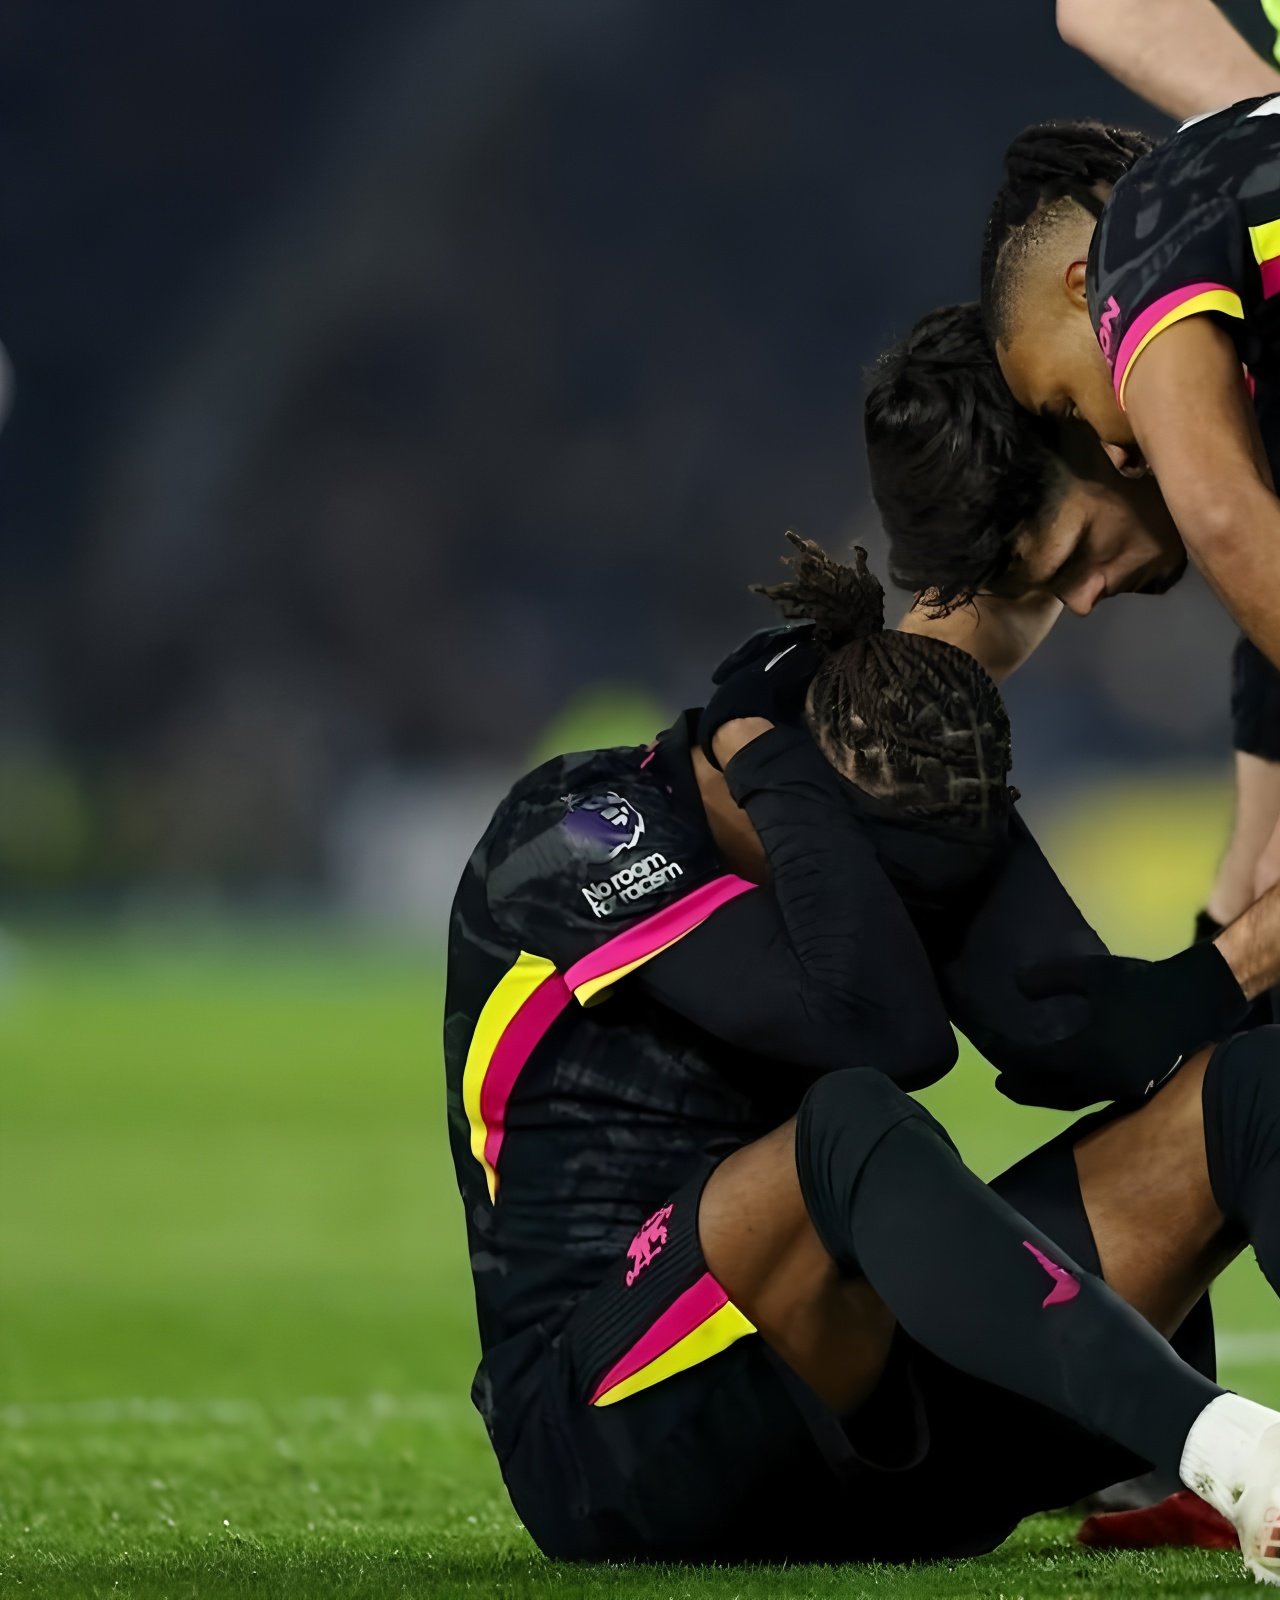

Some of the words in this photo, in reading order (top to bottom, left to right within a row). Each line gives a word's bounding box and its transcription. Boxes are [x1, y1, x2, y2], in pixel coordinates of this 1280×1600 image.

[581, 882, 612, 904] No
[610, 853, 667, 890] room
[619, 862, 684, 904] racism
